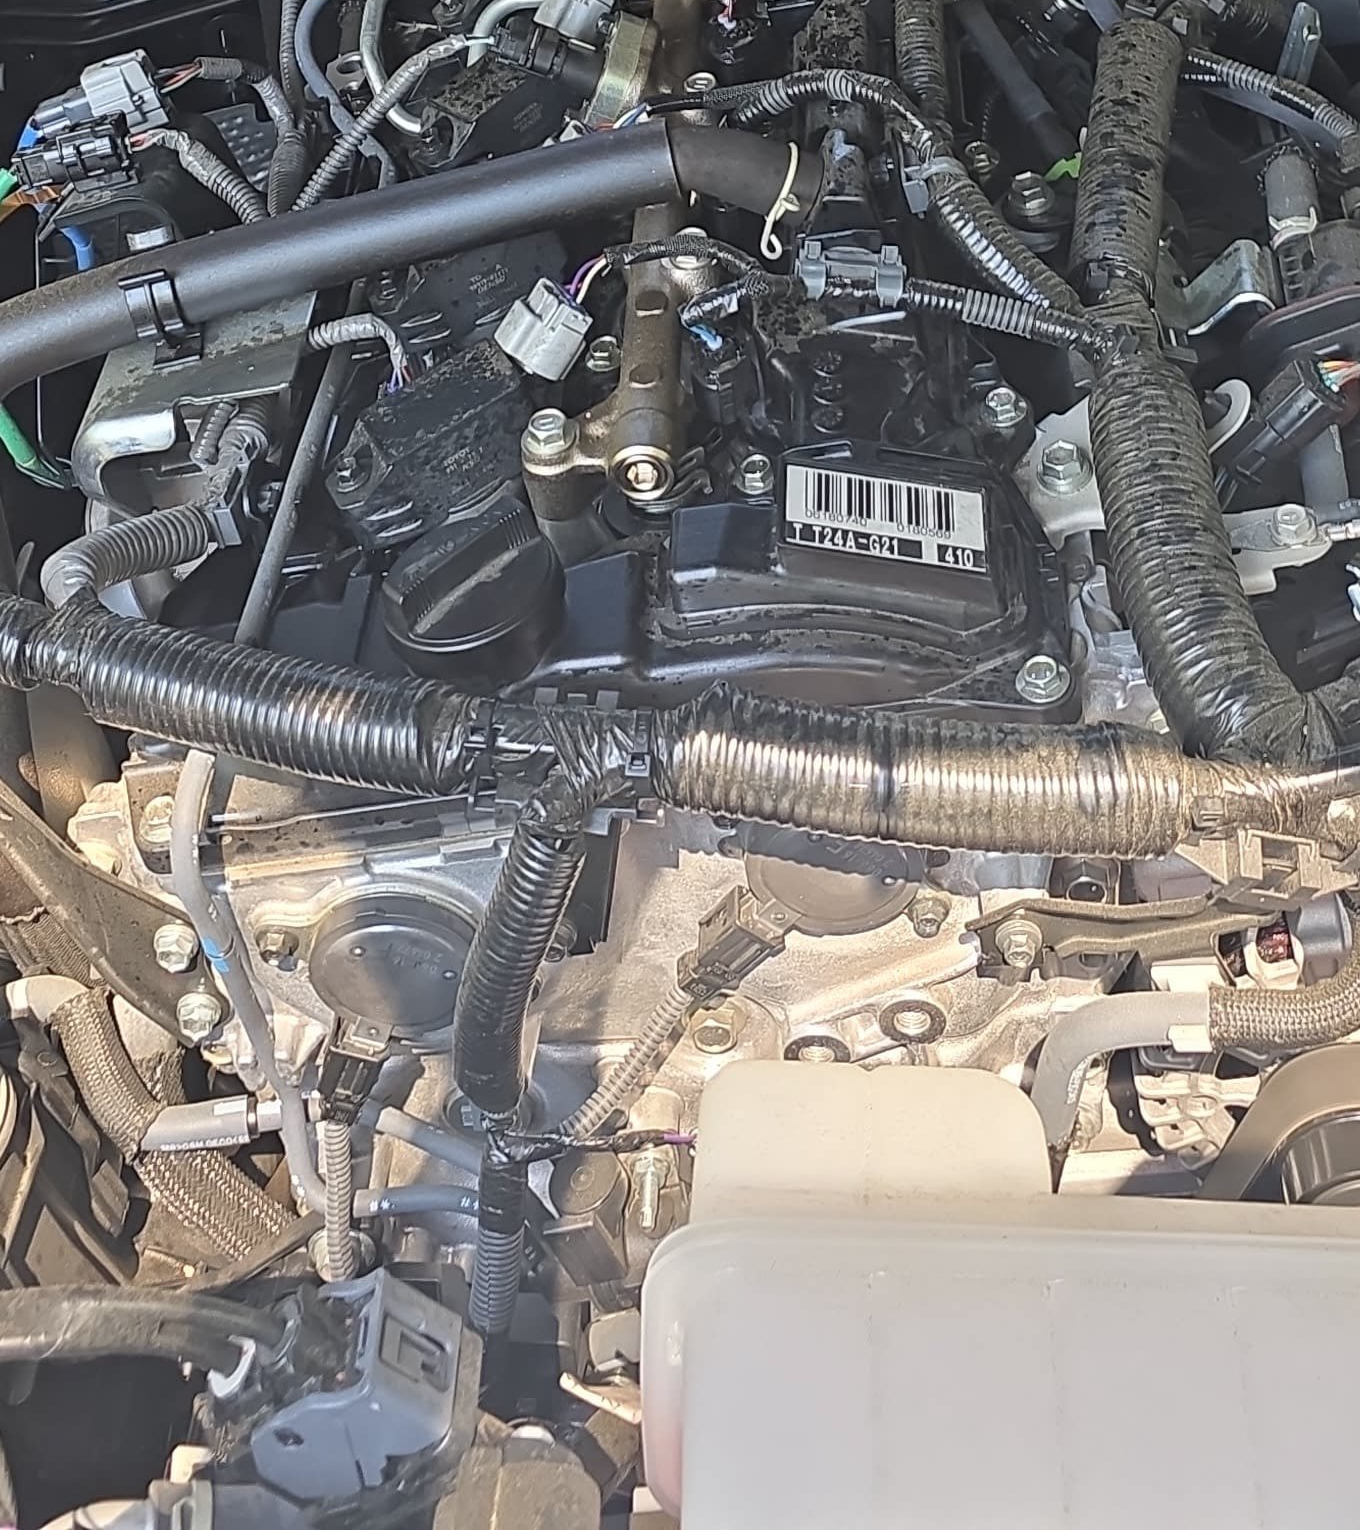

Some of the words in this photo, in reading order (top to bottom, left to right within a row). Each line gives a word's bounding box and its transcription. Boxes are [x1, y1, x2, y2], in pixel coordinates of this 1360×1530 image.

[792, 522, 803, 542] T
[812, 526, 899, 556] T24A-G21
[943, 547, 974, 568] 410
